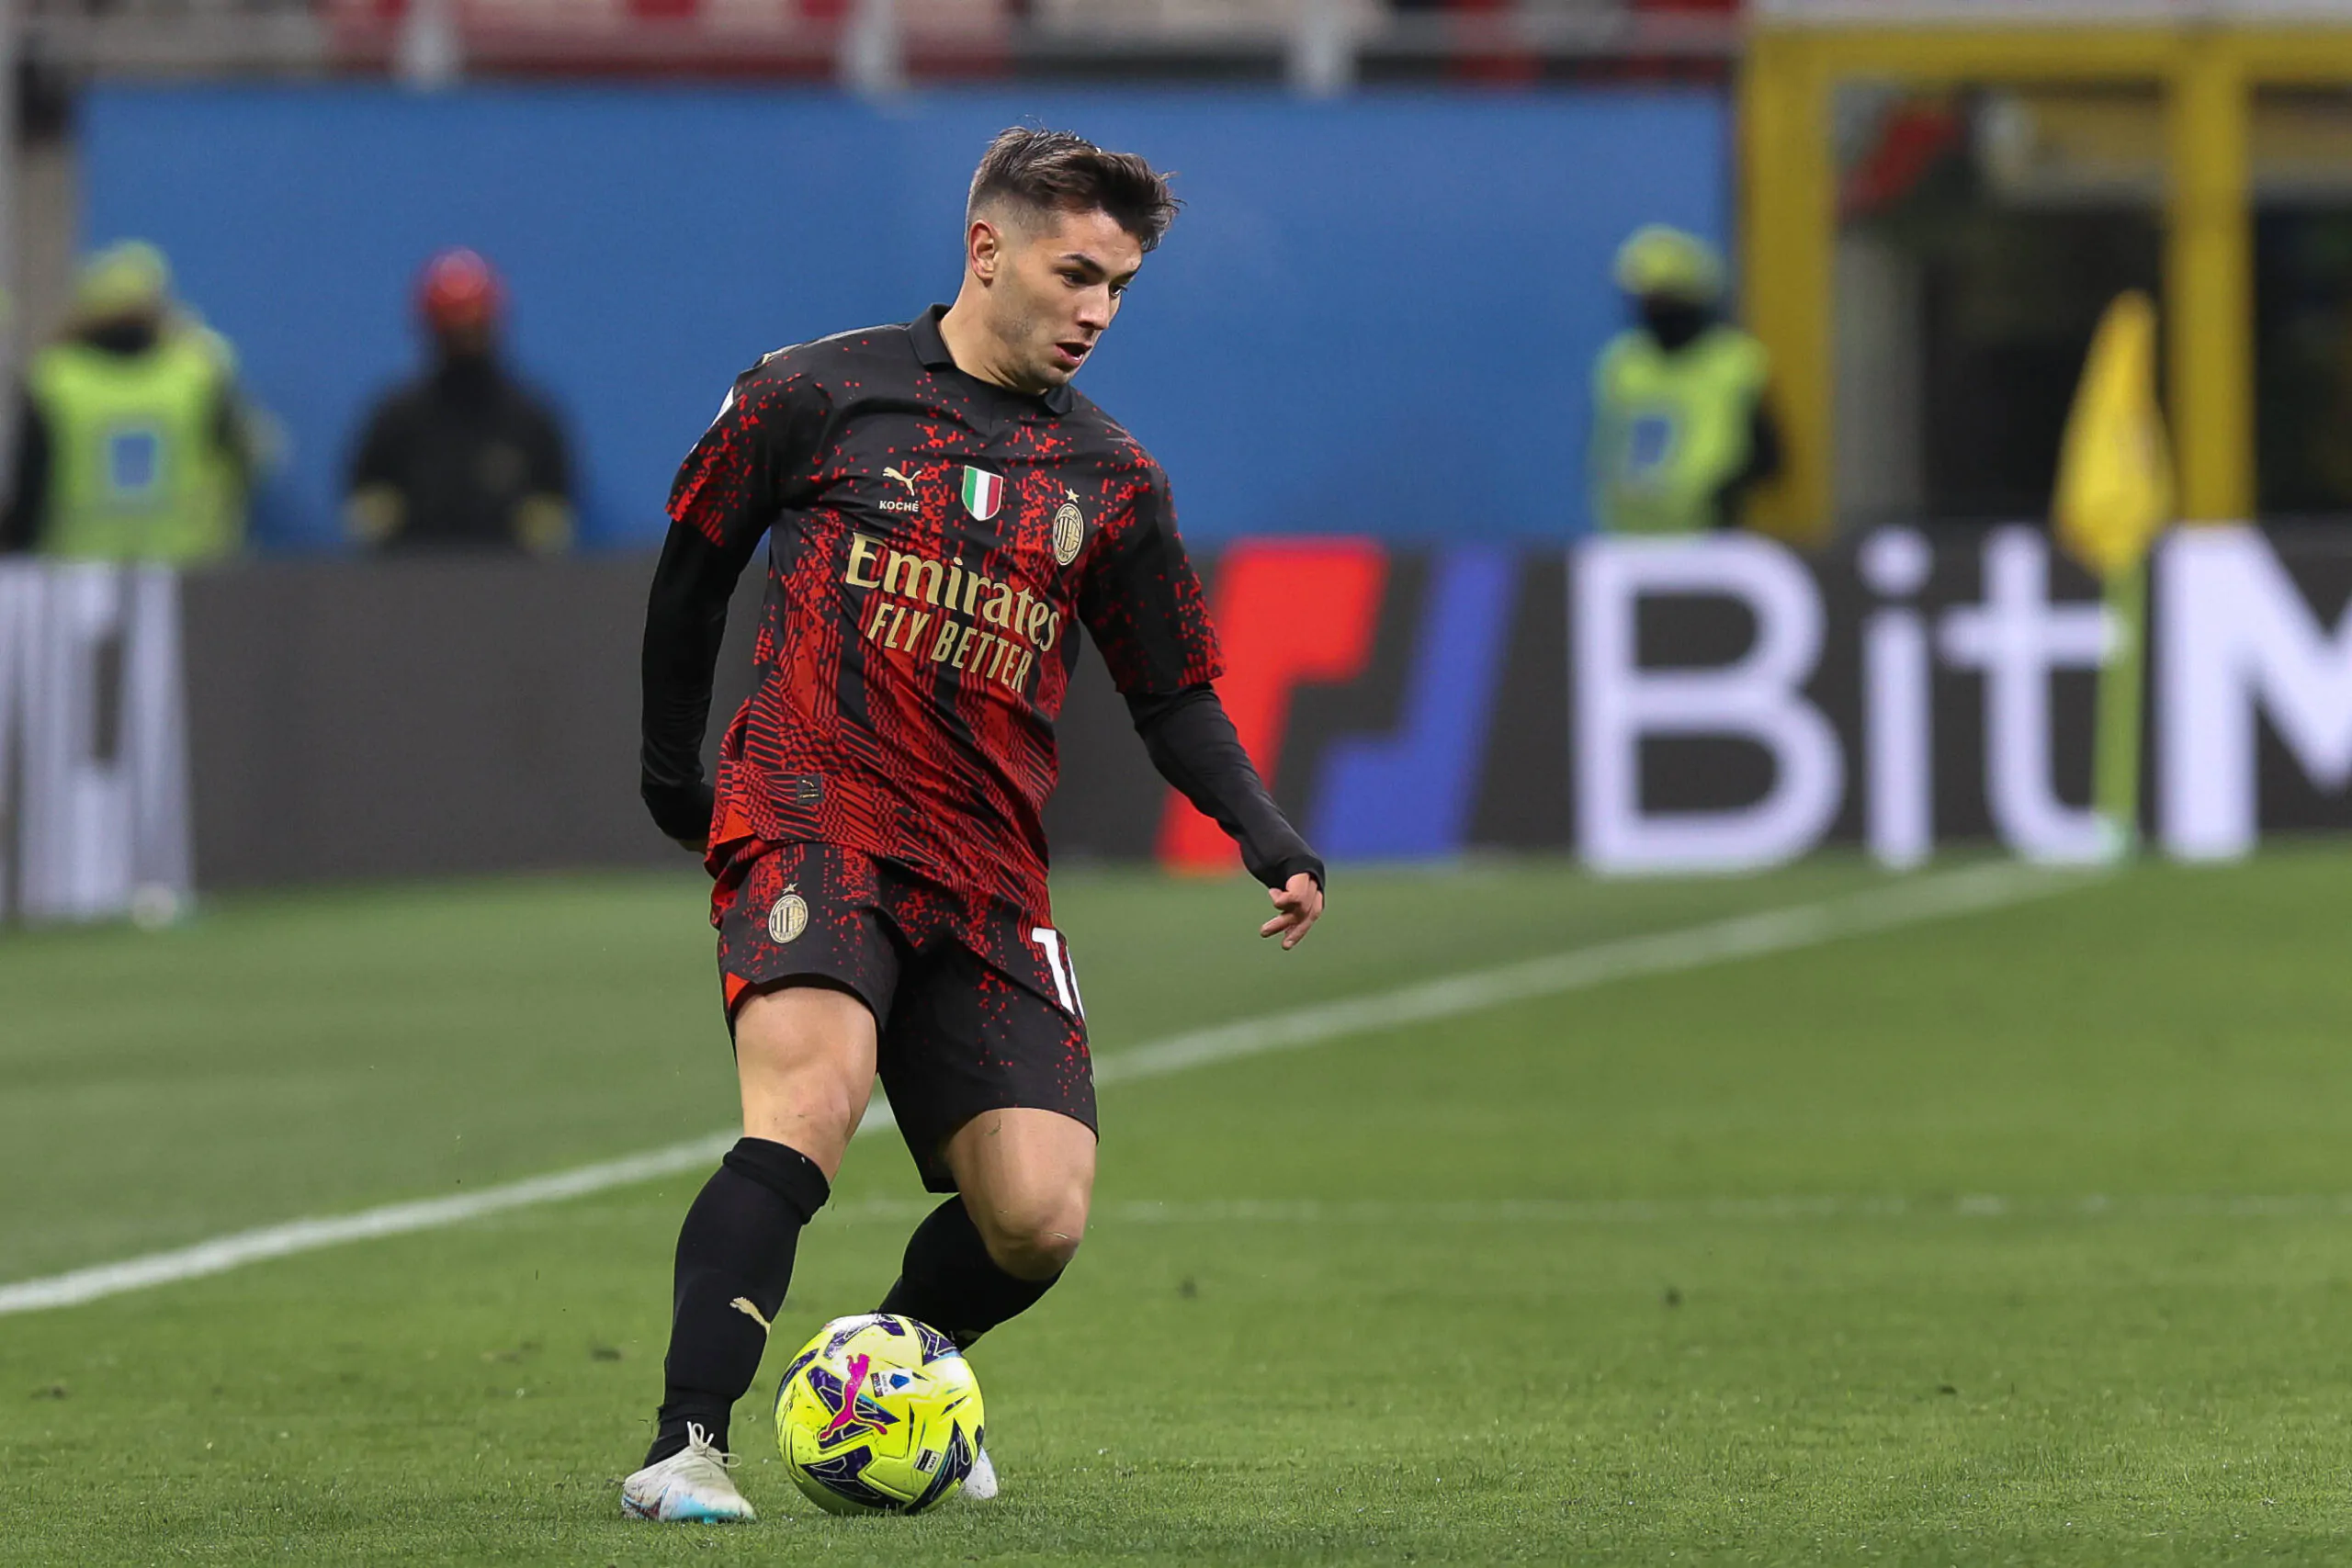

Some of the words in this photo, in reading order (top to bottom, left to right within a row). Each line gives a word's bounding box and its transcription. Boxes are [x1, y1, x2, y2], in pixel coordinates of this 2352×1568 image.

[845, 533, 1060, 651] Emirates
[867, 603, 931, 652] FLY
[931, 620, 1033, 693] BETTER
[1032, 927, 1085, 1021] 1
